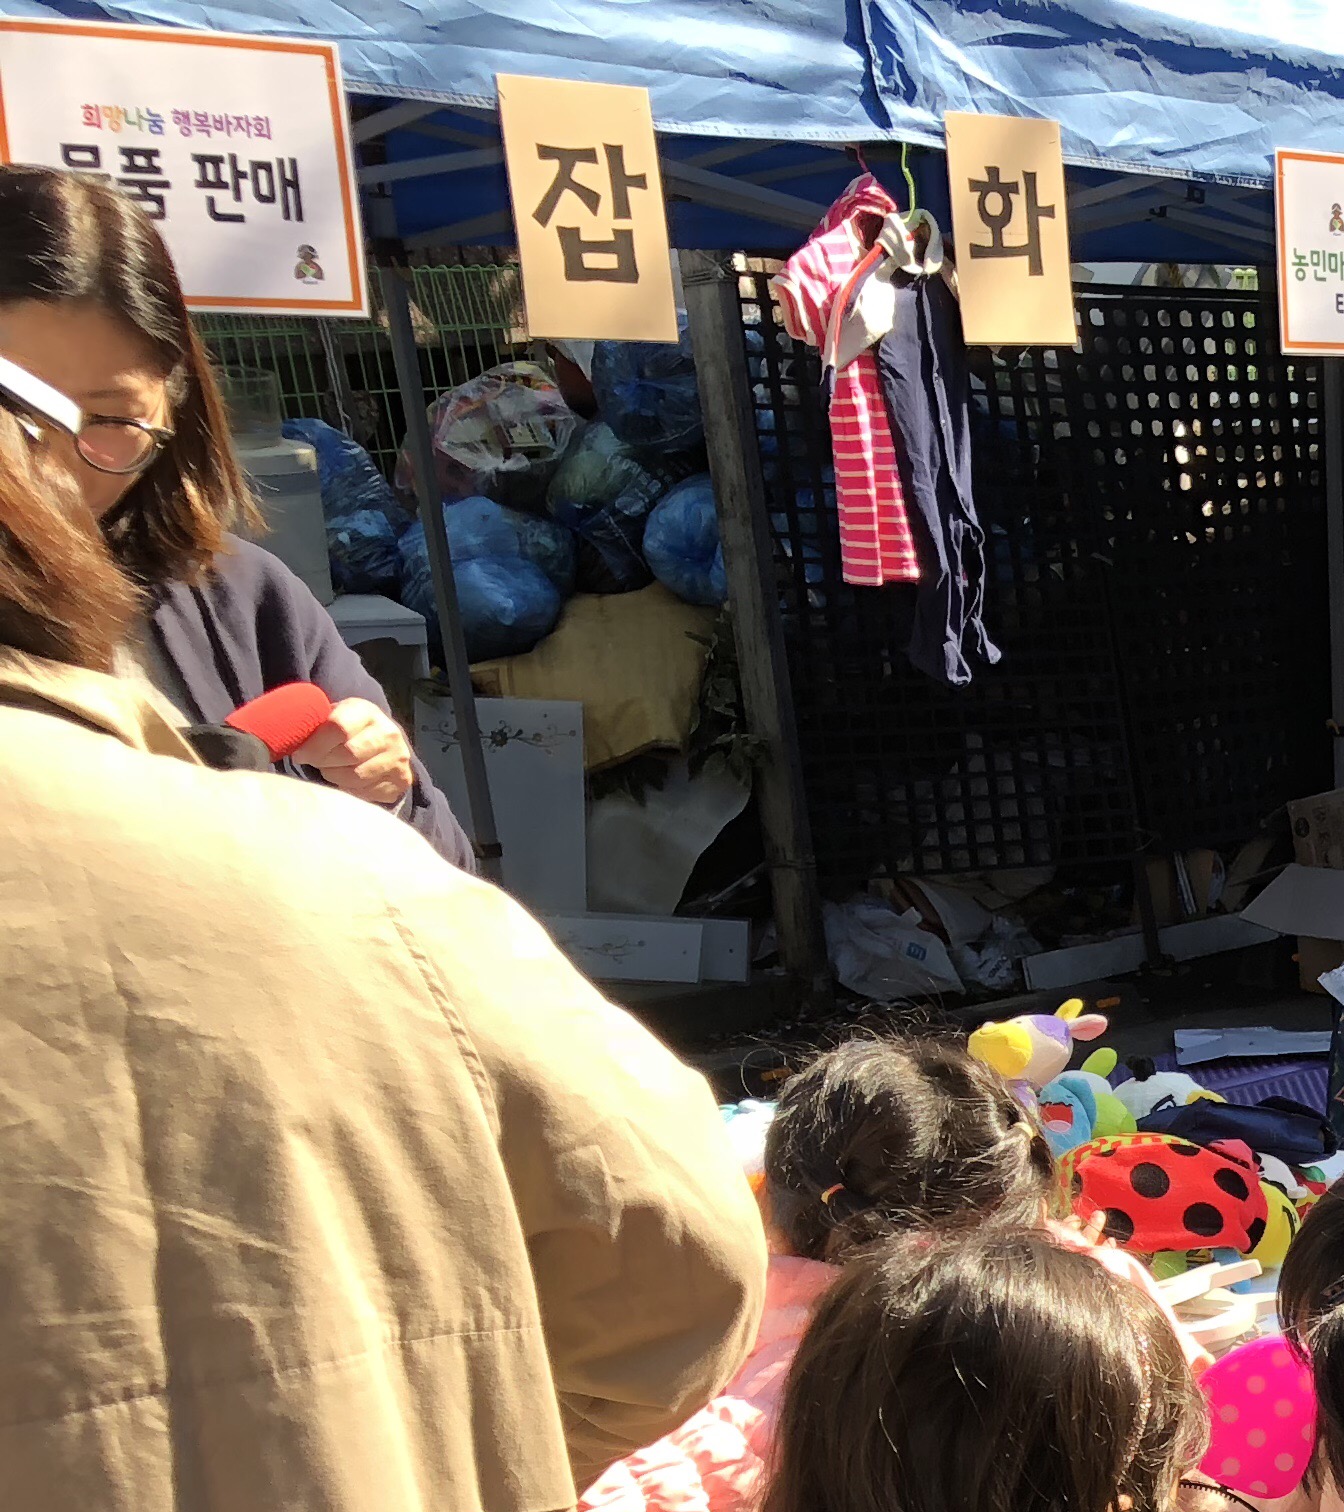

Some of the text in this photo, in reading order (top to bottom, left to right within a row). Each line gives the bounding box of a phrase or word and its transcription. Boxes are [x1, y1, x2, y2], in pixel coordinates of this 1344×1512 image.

[80, 104, 273, 140] 희망나눔 행복바자회
[190, 152, 305, 224] 판매
[531, 142, 648, 284] 잡
[967, 165, 1056, 277] 화
